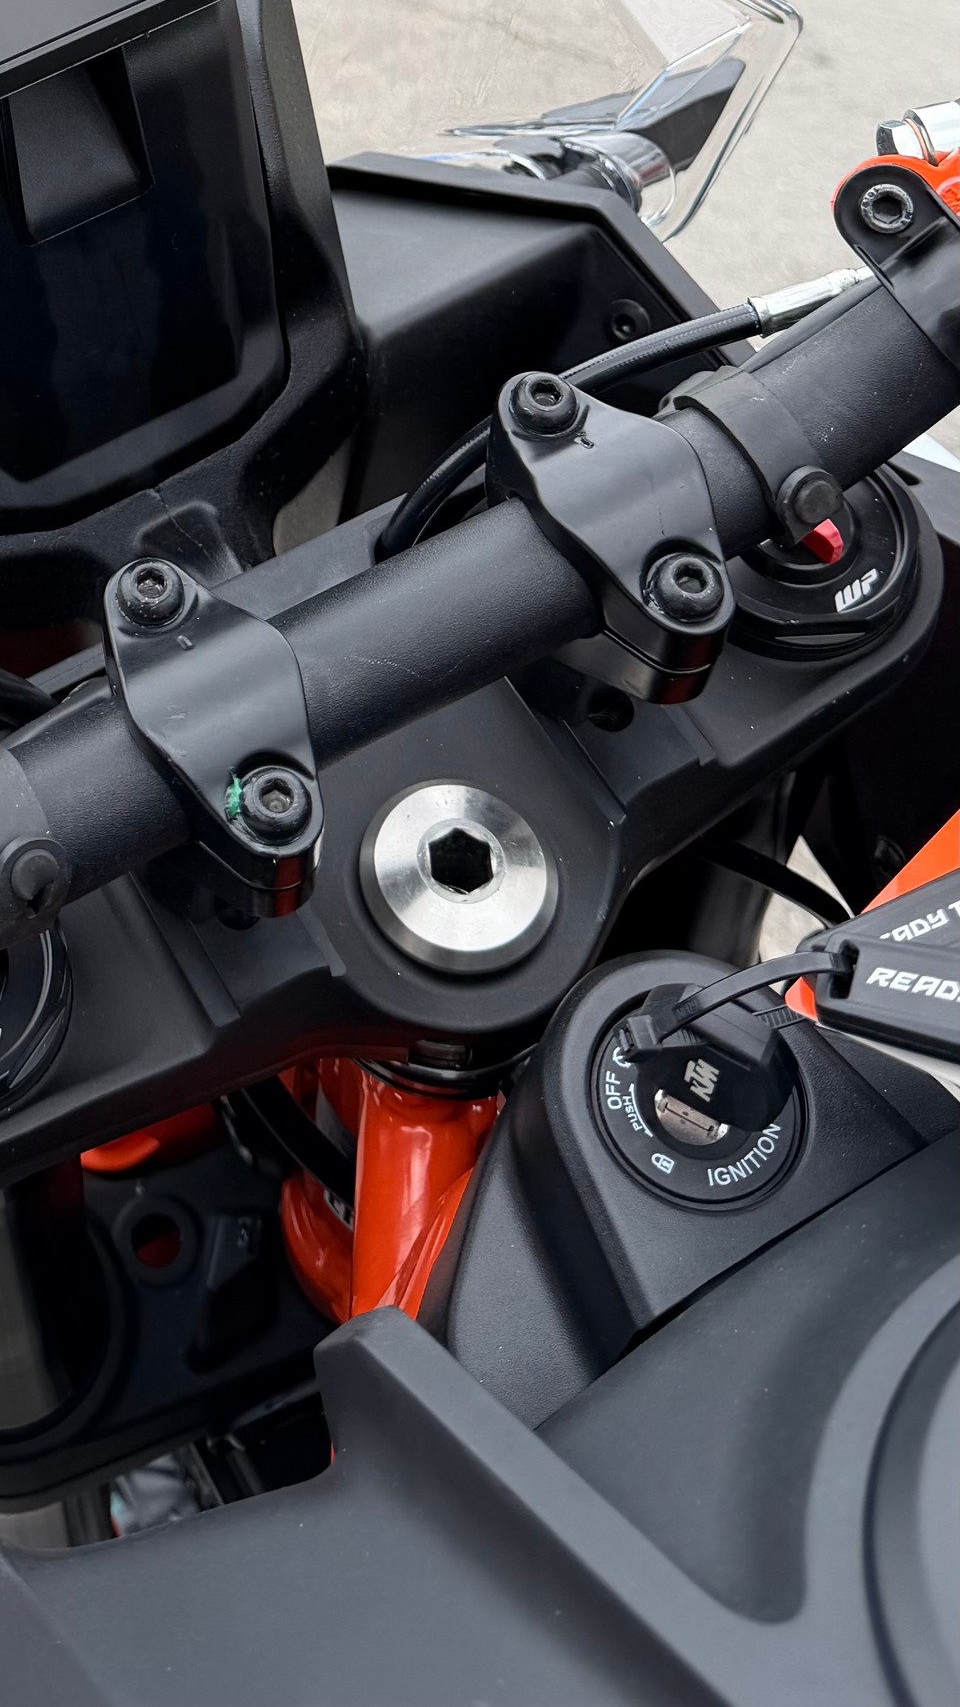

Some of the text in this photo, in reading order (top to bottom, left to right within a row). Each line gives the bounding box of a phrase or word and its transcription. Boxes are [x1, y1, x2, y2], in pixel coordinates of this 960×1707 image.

[834, 568, 880, 613] WP
[879, 908, 950, 942] ADY
[865, 967, 960, 1003] READ
[605, 1070, 623, 1110] OFF
[683, 1058, 720, 1103] KTM
[622, 1095, 643, 1131] PUSH
[707, 1123, 782, 1187] IGNITION
